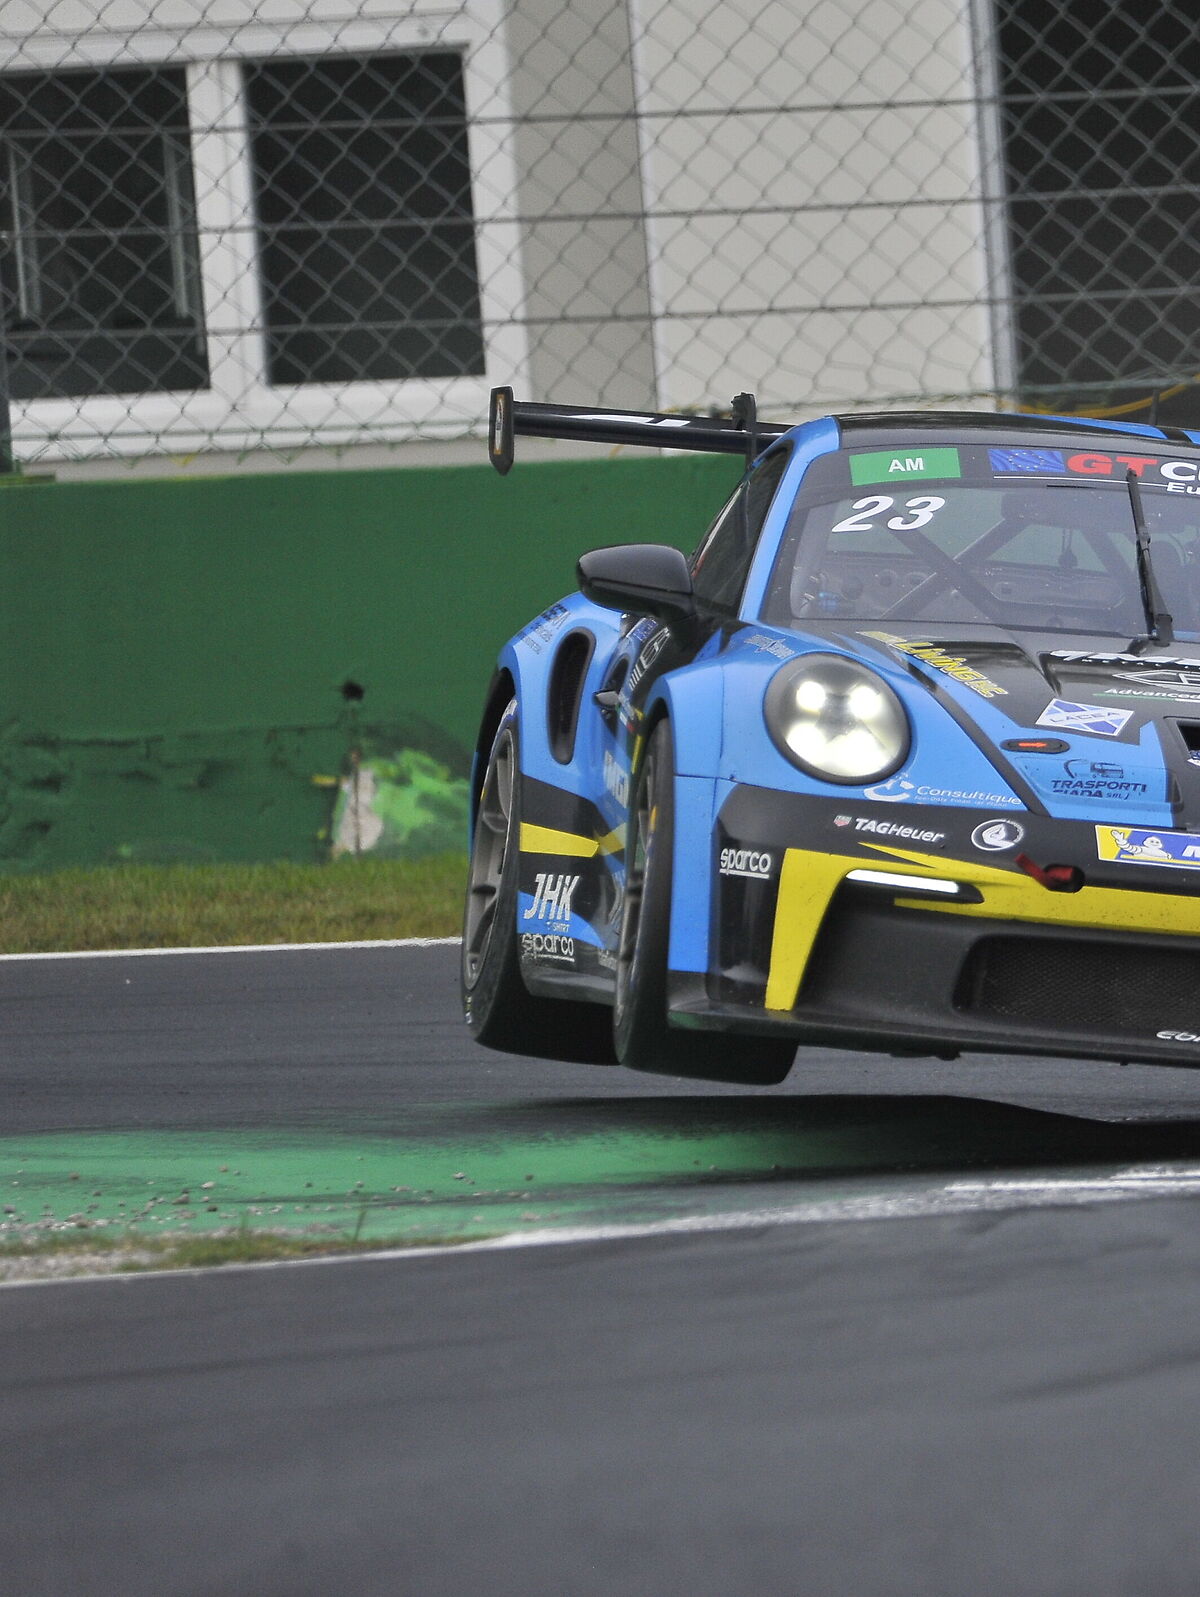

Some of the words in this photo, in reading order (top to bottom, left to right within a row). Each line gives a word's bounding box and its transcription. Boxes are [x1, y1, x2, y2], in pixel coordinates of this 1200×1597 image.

[888, 457, 925, 473] AM
[1066, 453, 1160, 478] GT
[831, 495, 946, 533] 23
[1049, 711, 1120, 723] LACEA
[916, 785, 1023, 806] Consultique
[1051, 779, 1147, 793] TRASPORTI
[719, 848, 772, 879] sparco
[523, 873, 580, 921] JHK
[521, 932, 575, 962] sparco
